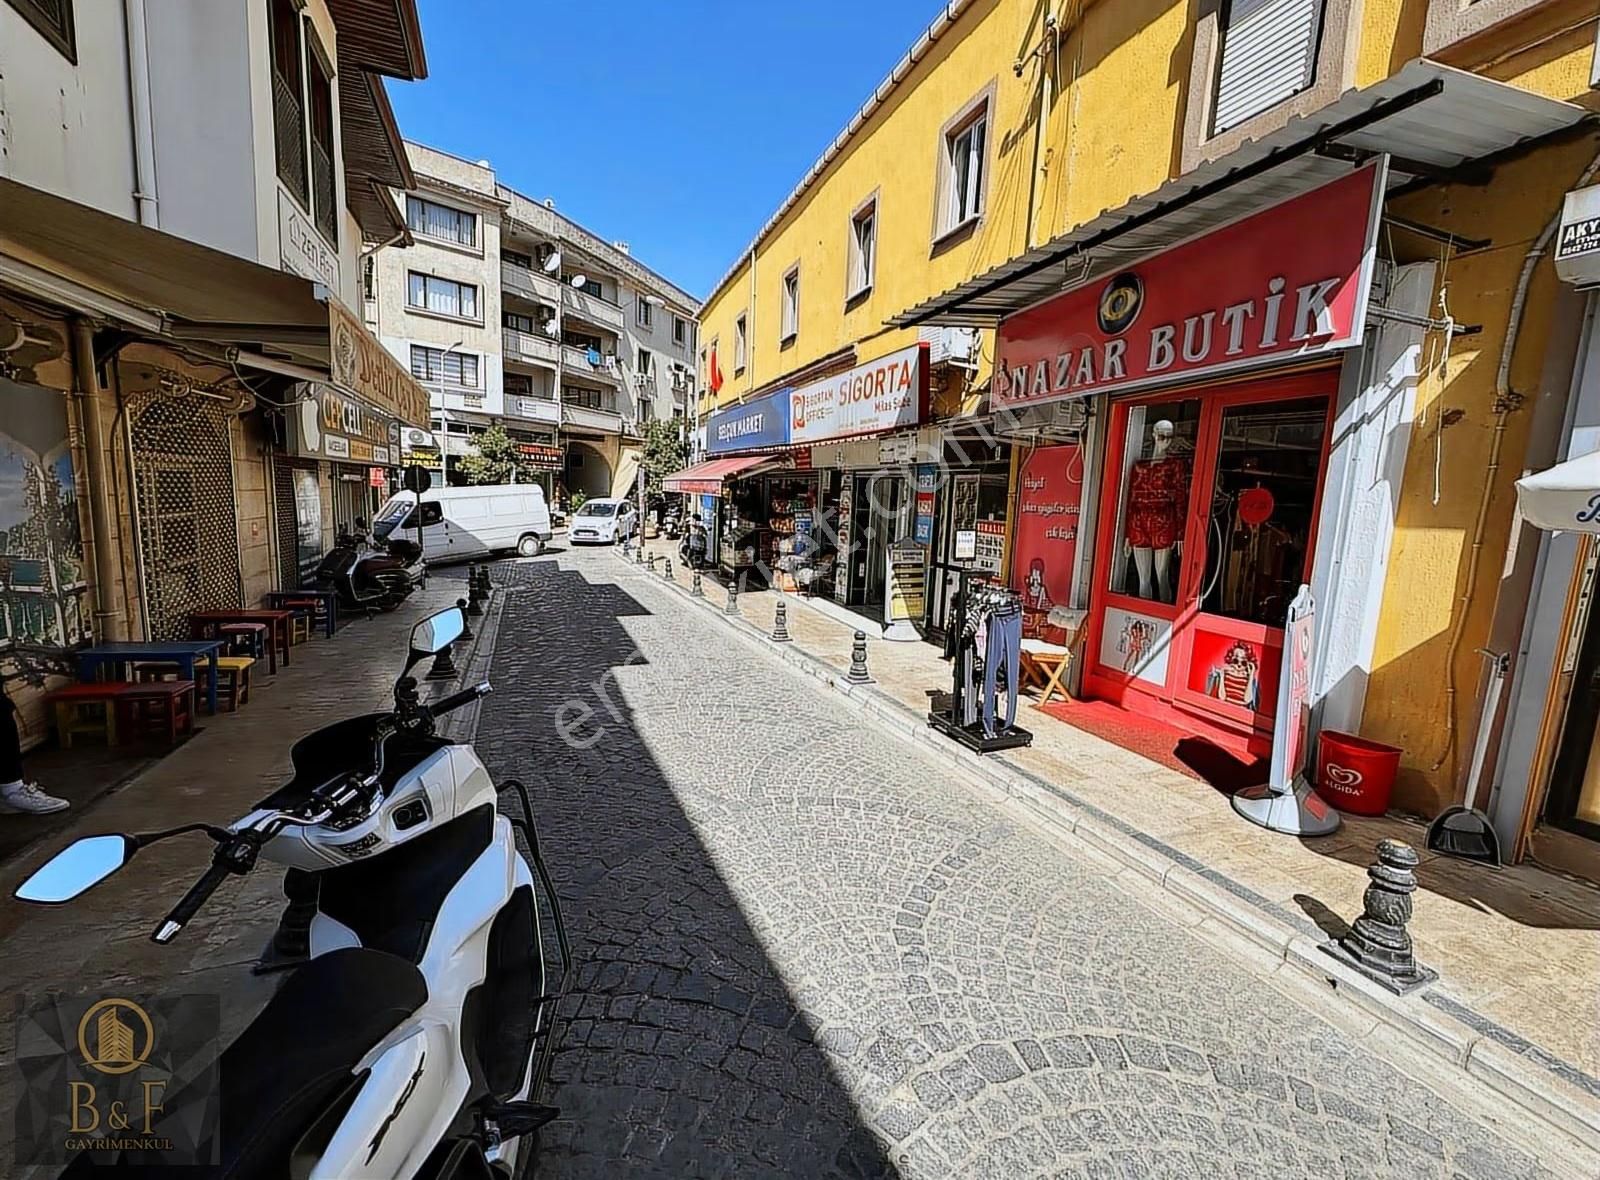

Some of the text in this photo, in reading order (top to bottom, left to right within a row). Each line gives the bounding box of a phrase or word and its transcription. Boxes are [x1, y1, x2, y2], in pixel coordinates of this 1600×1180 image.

[1010, 277, 1340, 400] NAZAR BUTİK
[839, 358, 912, 406] SİGORTA
[738, 413, 763, 436] MARKET
